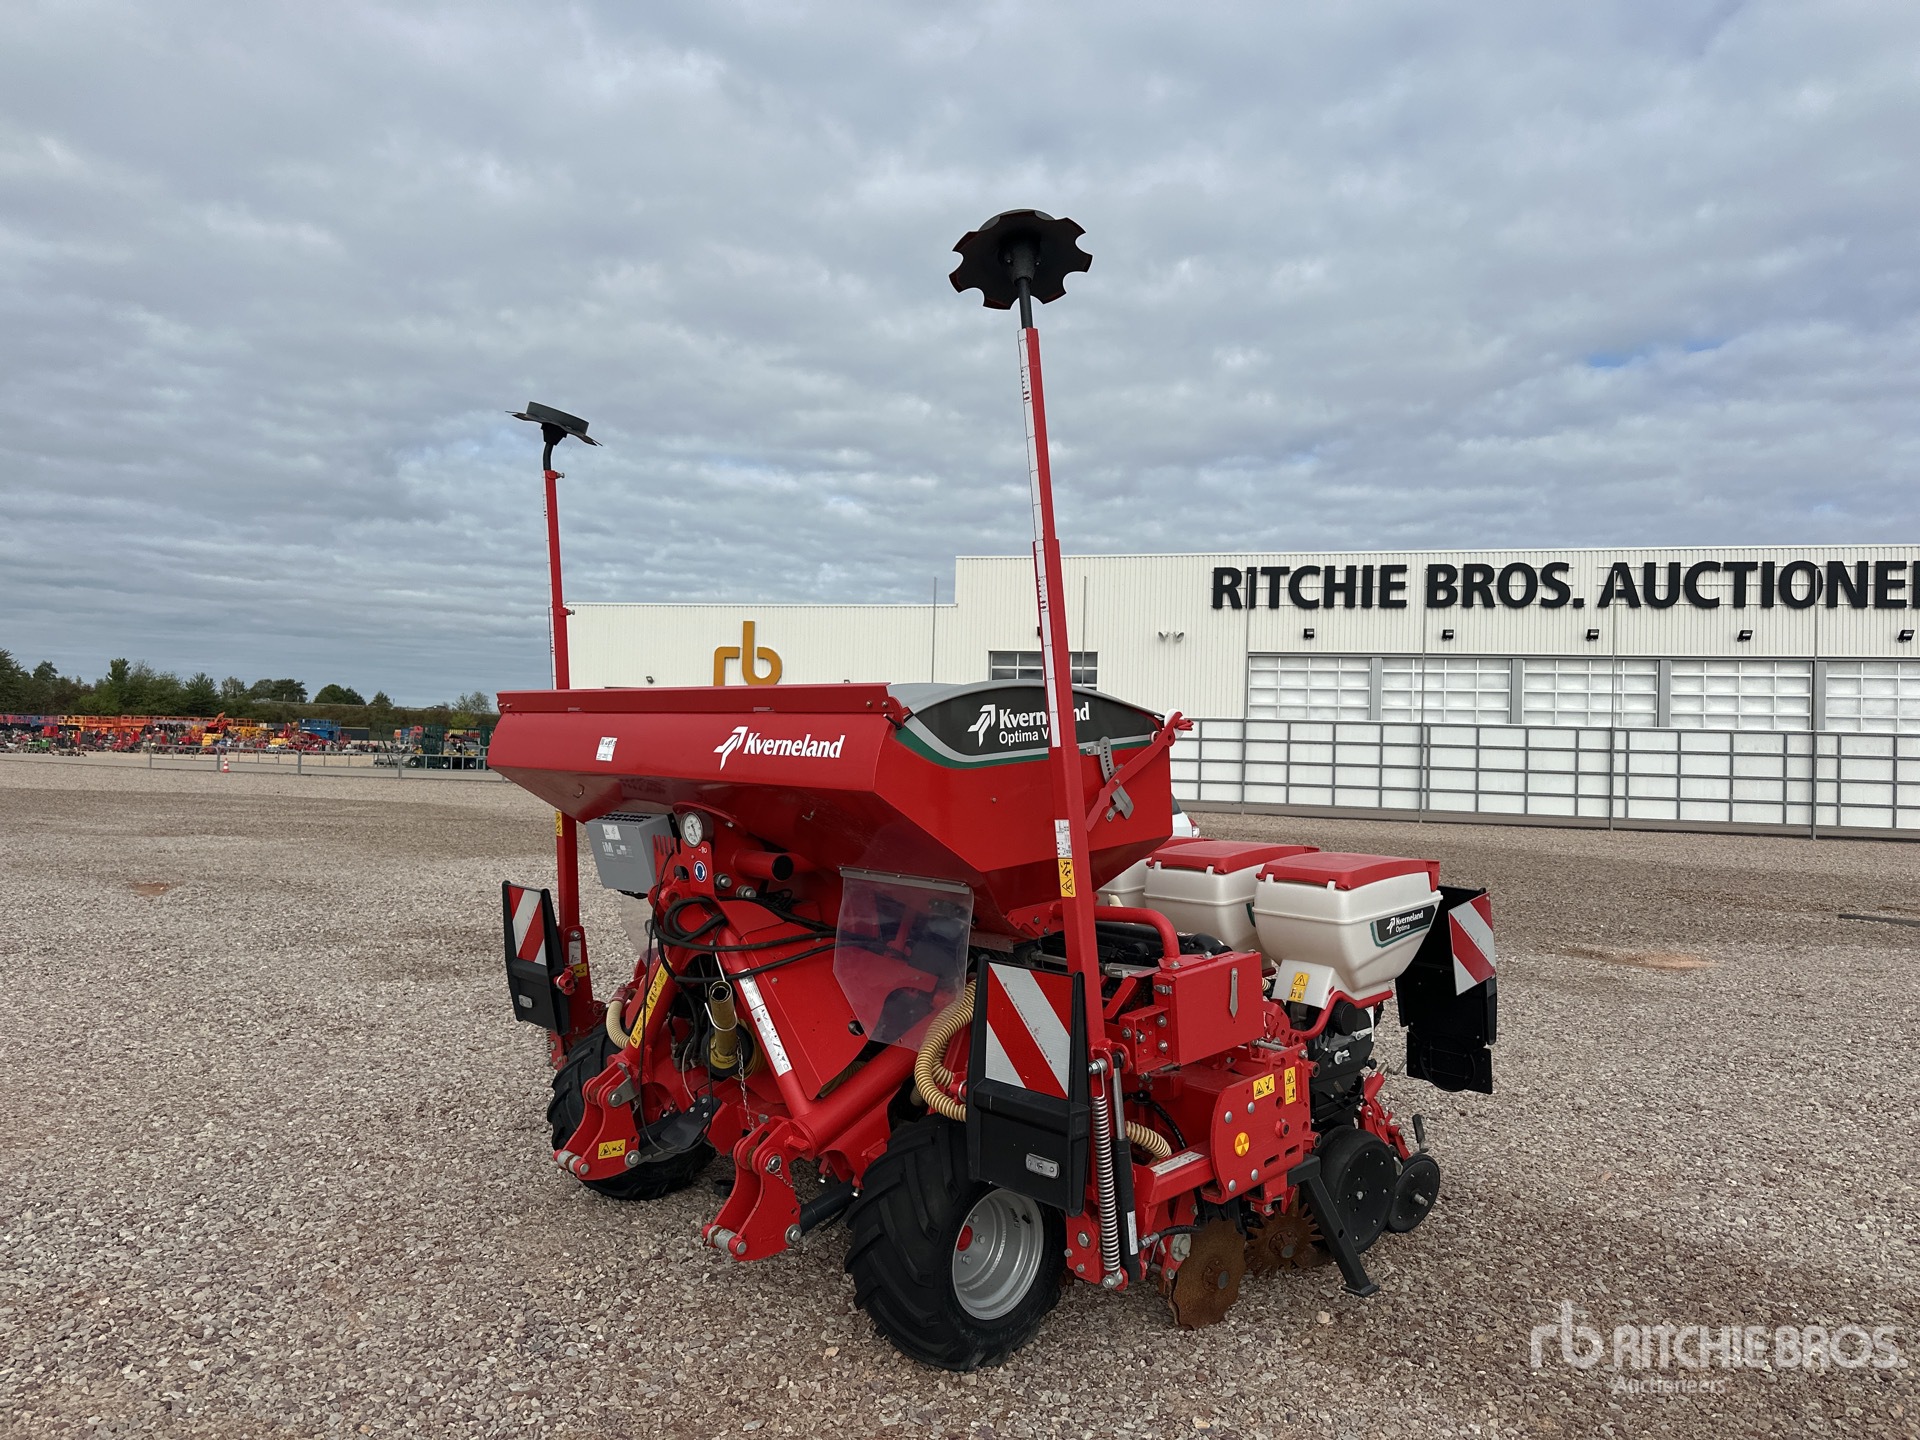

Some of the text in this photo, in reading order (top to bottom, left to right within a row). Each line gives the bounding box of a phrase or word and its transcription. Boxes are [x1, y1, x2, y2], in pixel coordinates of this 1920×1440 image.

[1212, 560, 1920, 610] RITCHIE BROS. AUCTIONE
[713, 620, 783, 686] rb
[999, 701, 1090, 730] Kvernnd
[743, 732, 846, 758] Kverneland
[999, 731, 1039, 747] Optima
[1395, 909, 1424, 925] Kverneland
[1395, 924, 1411, 933] Optima
